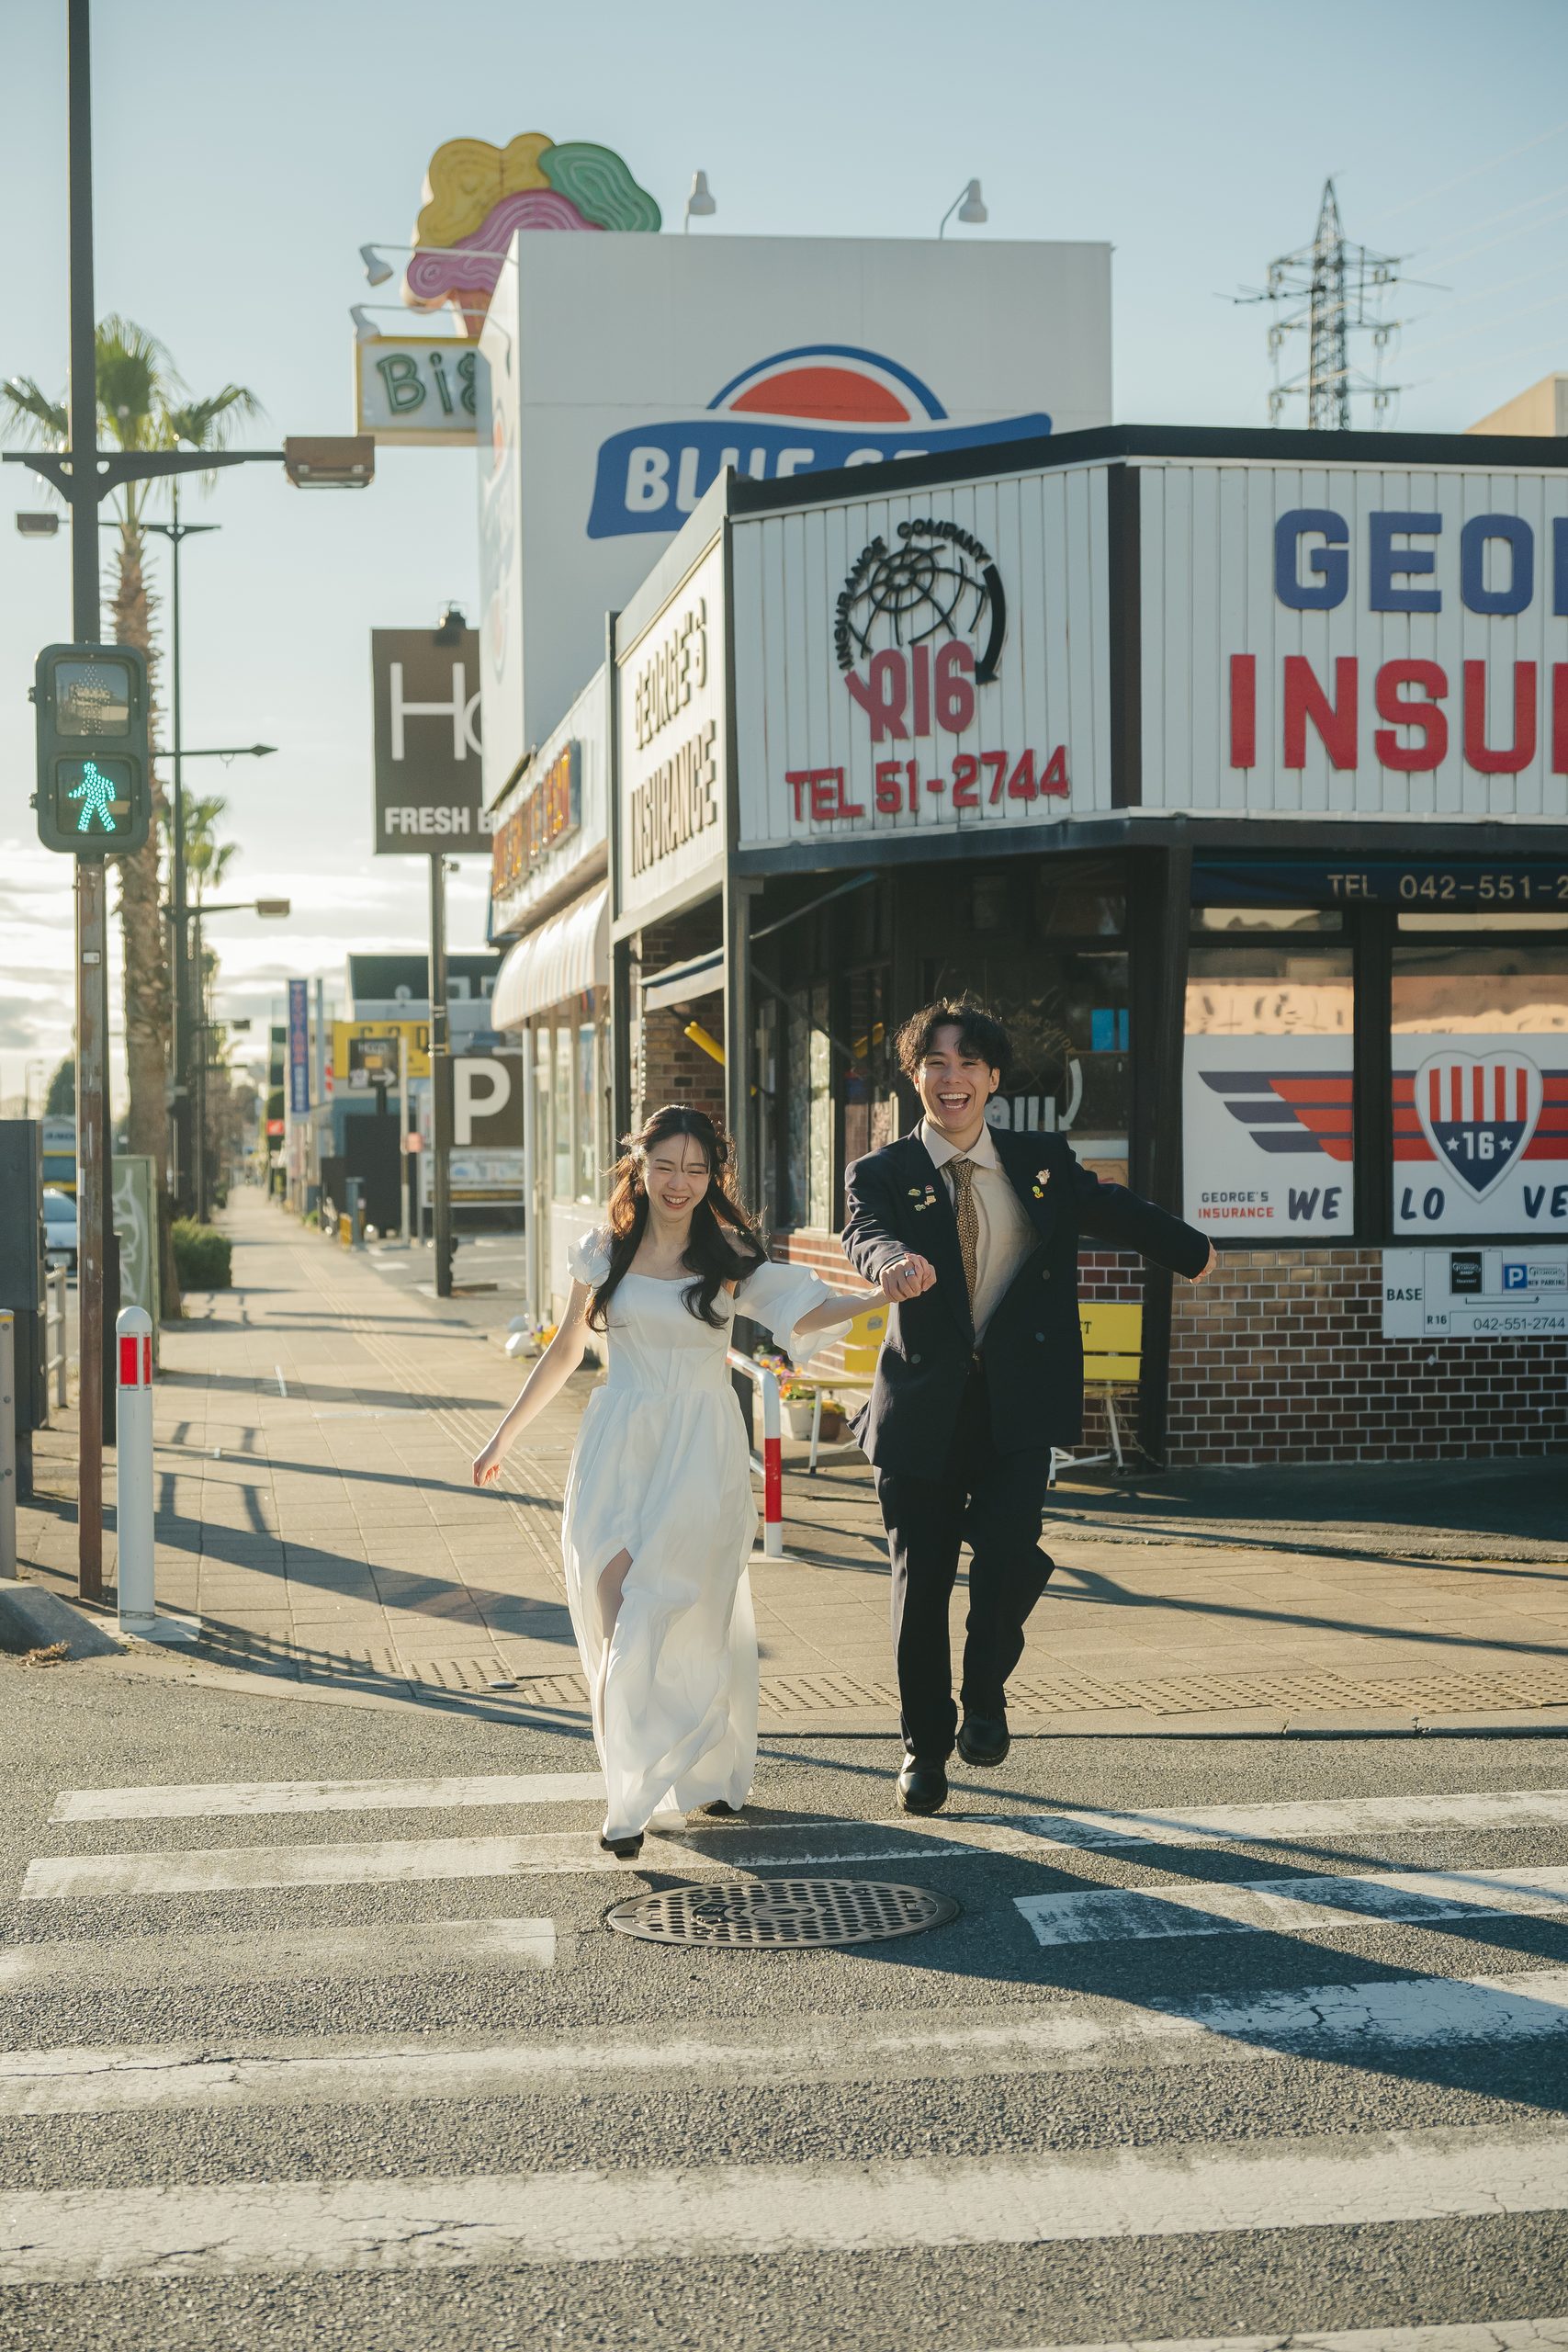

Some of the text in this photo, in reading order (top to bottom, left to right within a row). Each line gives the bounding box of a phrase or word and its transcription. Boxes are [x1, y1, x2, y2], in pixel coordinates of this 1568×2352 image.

[897, 517, 992, 563] COMPANY
[1274, 508, 1568, 616] GEO
[834, 535, 887, 670] INSURANCE
[1230, 653, 1568, 775] INSU
[631, 718, 716, 877] INSURANCE
[785, 745, 1069, 821] TEL 51-2744
[384, 806, 470, 835] FRESH
[1327, 875, 1377, 899] TEL
[454, 1057, 512, 1146] P
[1462, 1132, 1495, 1160] 16
[1198, 1207, 1275, 1218] INSURANCE
[1201, 1192, 1269, 1203] GEORGE'S
[1288, 1186, 1343, 1221] WE
[1508, 1268, 1524, 1287] P
[1386, 1288, 1423, 1301] BASE
[1473, 1316, 1566, 1331] 042-551-2744
